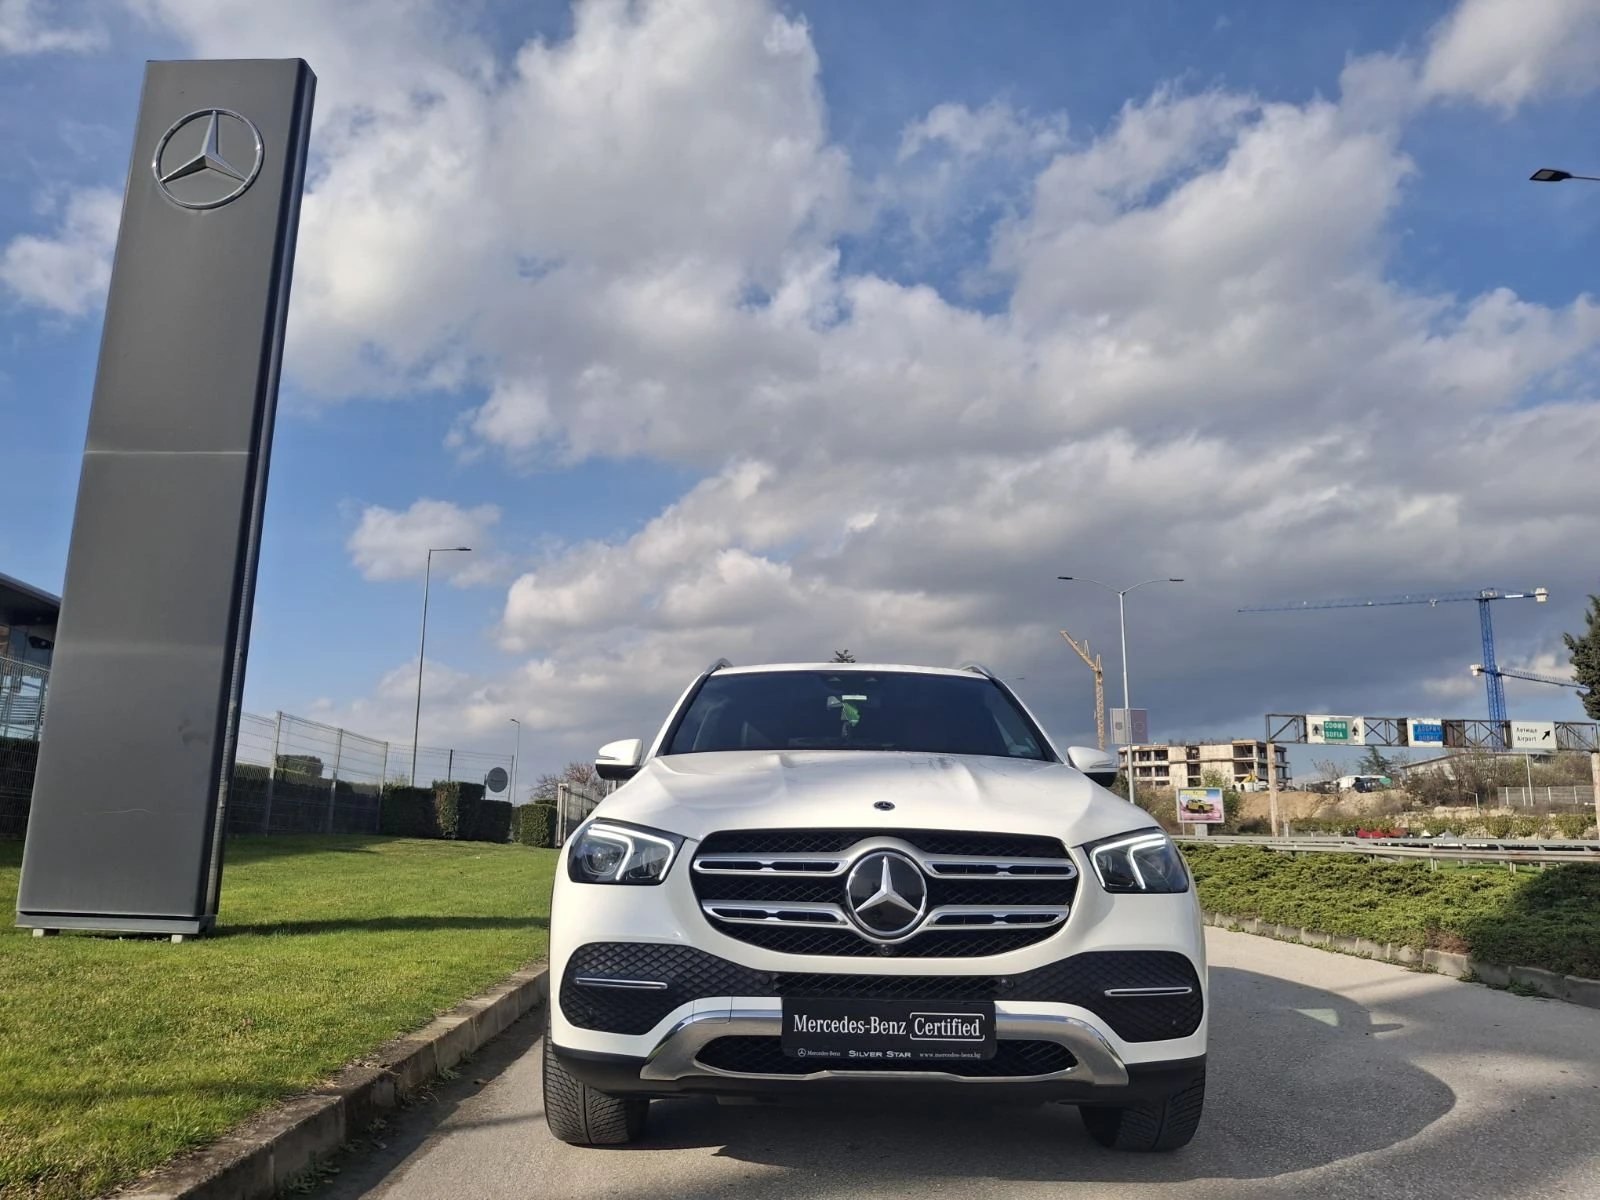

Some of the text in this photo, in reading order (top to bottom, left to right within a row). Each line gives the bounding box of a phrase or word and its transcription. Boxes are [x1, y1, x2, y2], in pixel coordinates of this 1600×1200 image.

[793, 1014, 980, 1036] Mercedes-Benz Certified
[807, 1049, 841, 1057] Mercedes-Benz
